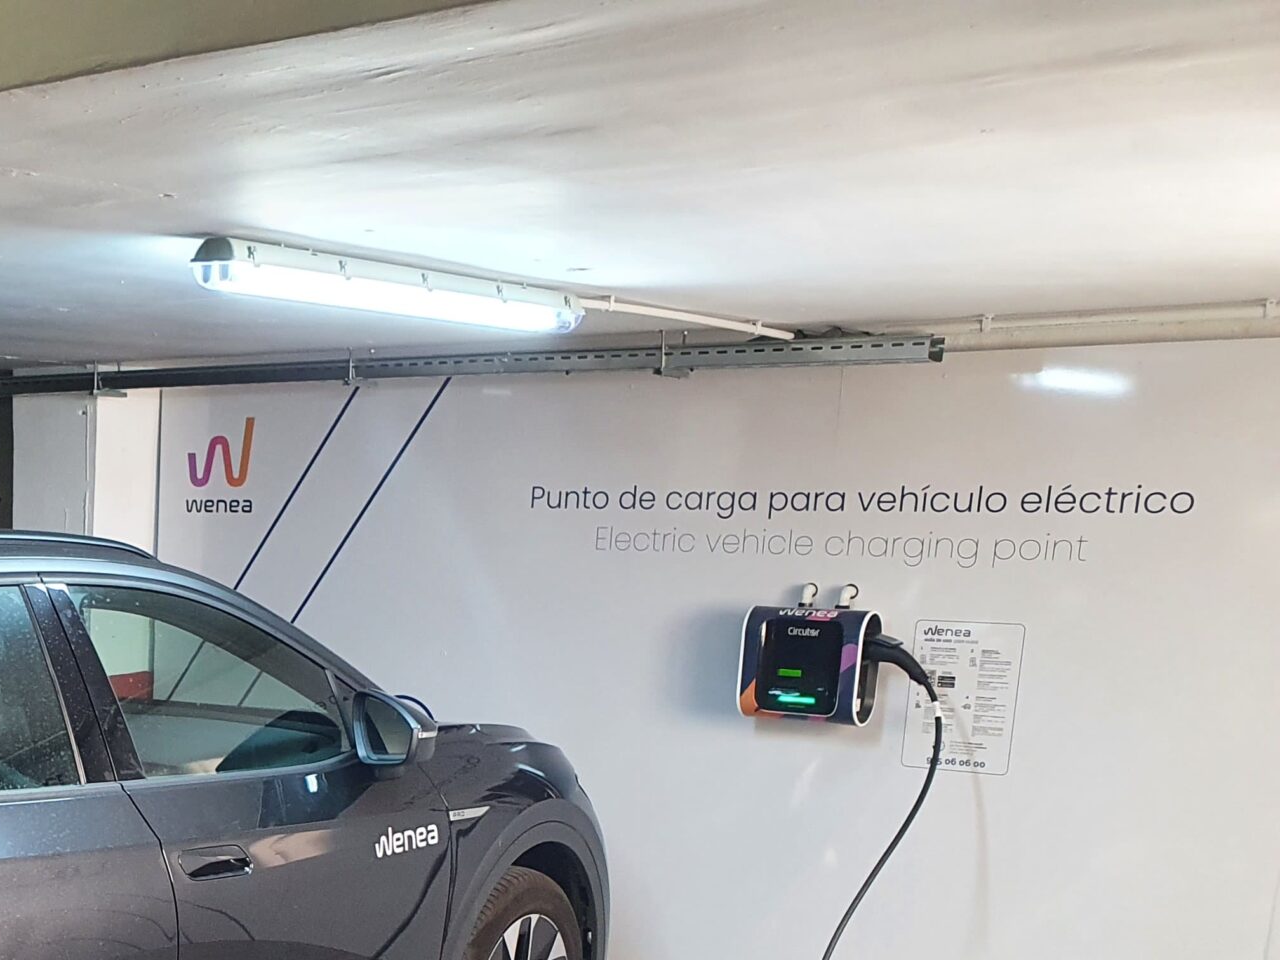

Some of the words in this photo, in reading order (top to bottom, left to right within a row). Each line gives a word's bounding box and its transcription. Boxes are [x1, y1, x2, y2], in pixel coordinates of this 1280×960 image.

[185, 498, 253, 514] wenea
[530, 485, 610, 510] Punto
[618, 484, 657, 511] de
[665, 489, 758, 519] carga
[767, 490, 847, 520] para
[857, 484, 1008, 514] vehículo
[1020, 483, 1196, 515] eléctrico
[594, 525, 696, 554] Electric
[705, 526, 814, 556] vehicle
[824, 529, 980, 569] charging
[991, 532, 1089, 569] point
